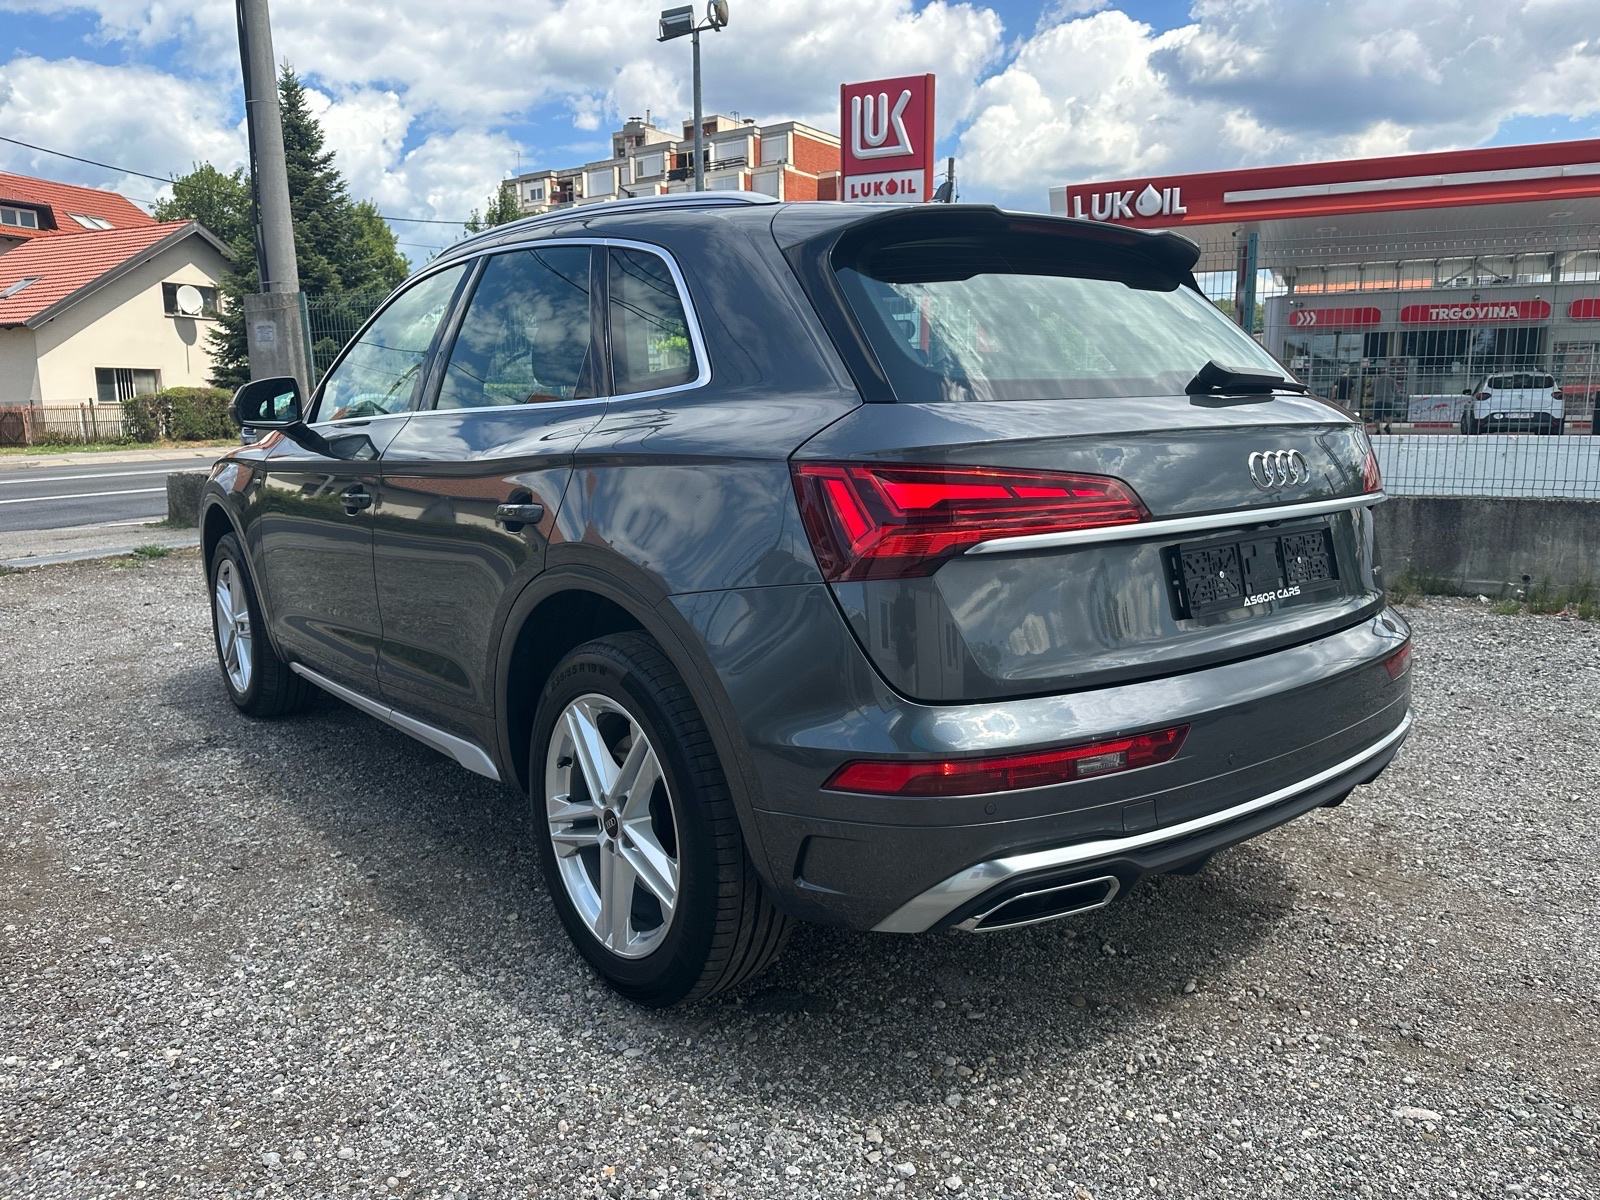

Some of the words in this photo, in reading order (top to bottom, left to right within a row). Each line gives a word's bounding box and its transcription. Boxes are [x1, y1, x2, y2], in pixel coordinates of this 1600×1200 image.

[852, 89, 914, 160] LUK
[851, 178, 916, 199] LUKOIL
[1073, 183, 1188, 221] LUKOIL
[1429, 305, 1519, 320] TRGOVINA
[1244, 591, 1276, 607] ASGOR
[1276, 585, 1301, 599] CARS
